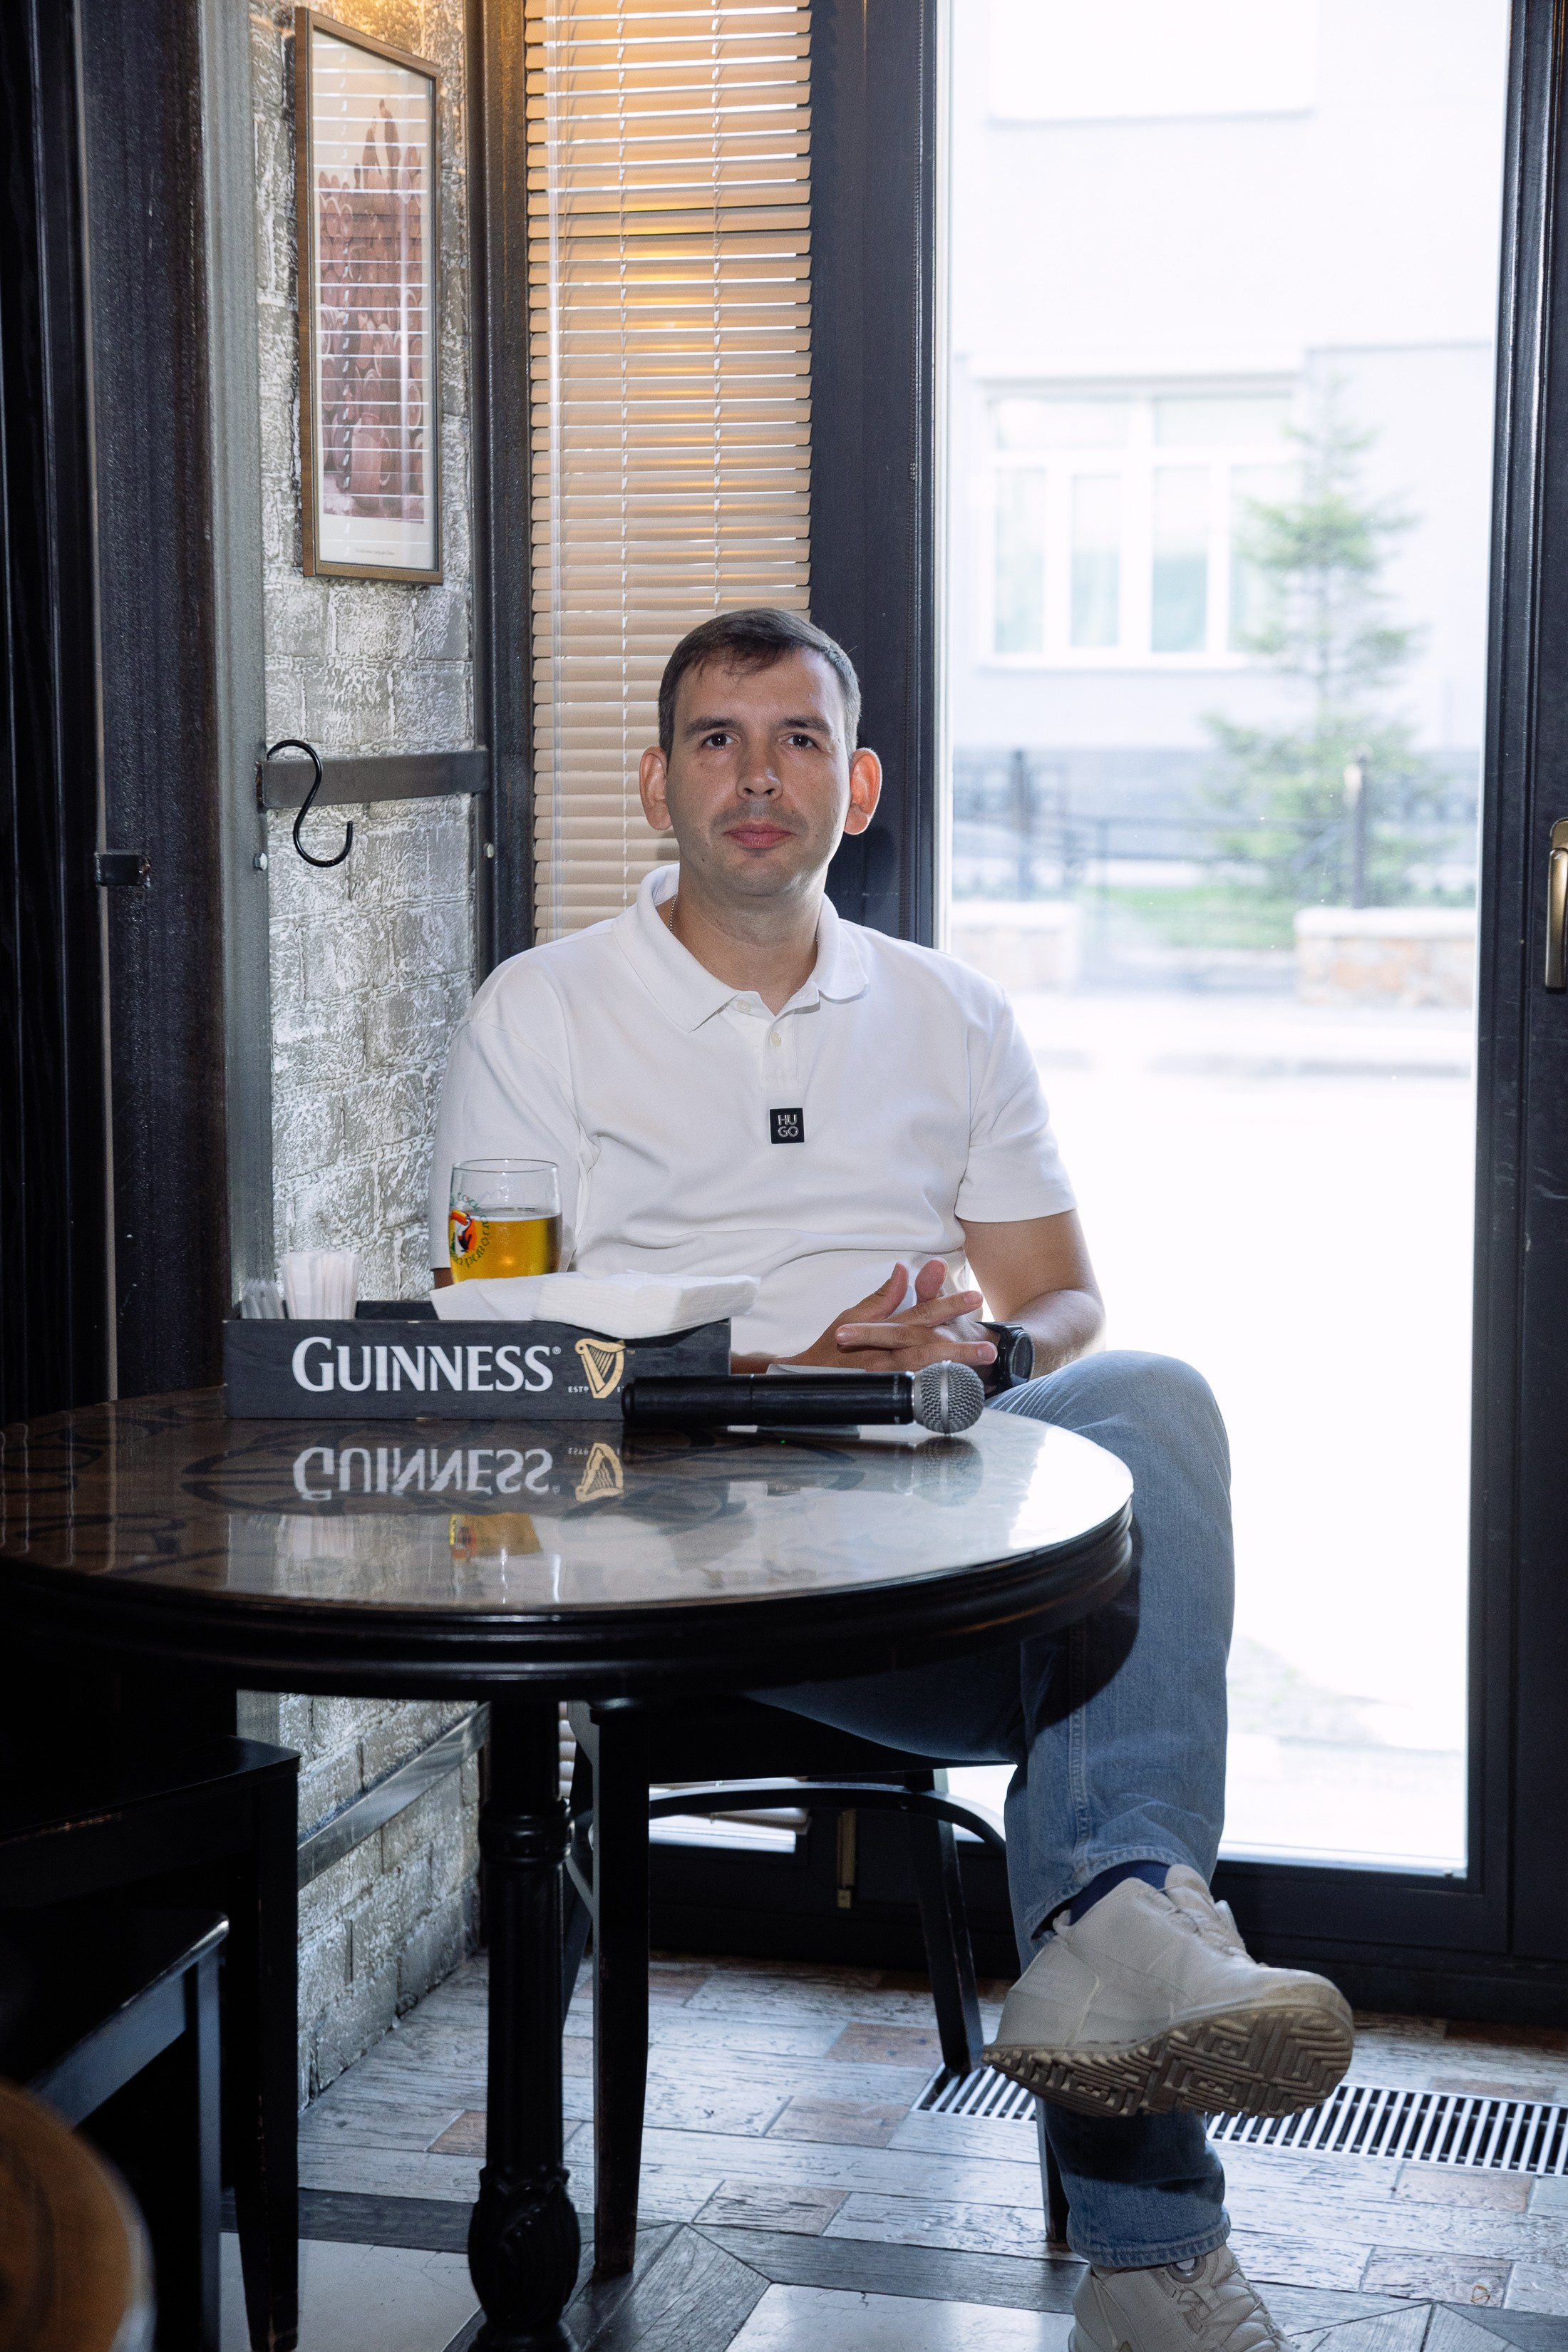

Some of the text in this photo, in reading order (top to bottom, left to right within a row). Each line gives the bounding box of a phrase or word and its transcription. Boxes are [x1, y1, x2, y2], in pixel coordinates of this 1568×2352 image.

[778, 1114, 798, 1125] HU
[778, 1126, 799, 1138] GO
[292, 1336, 554, 1392] GUINNESS
